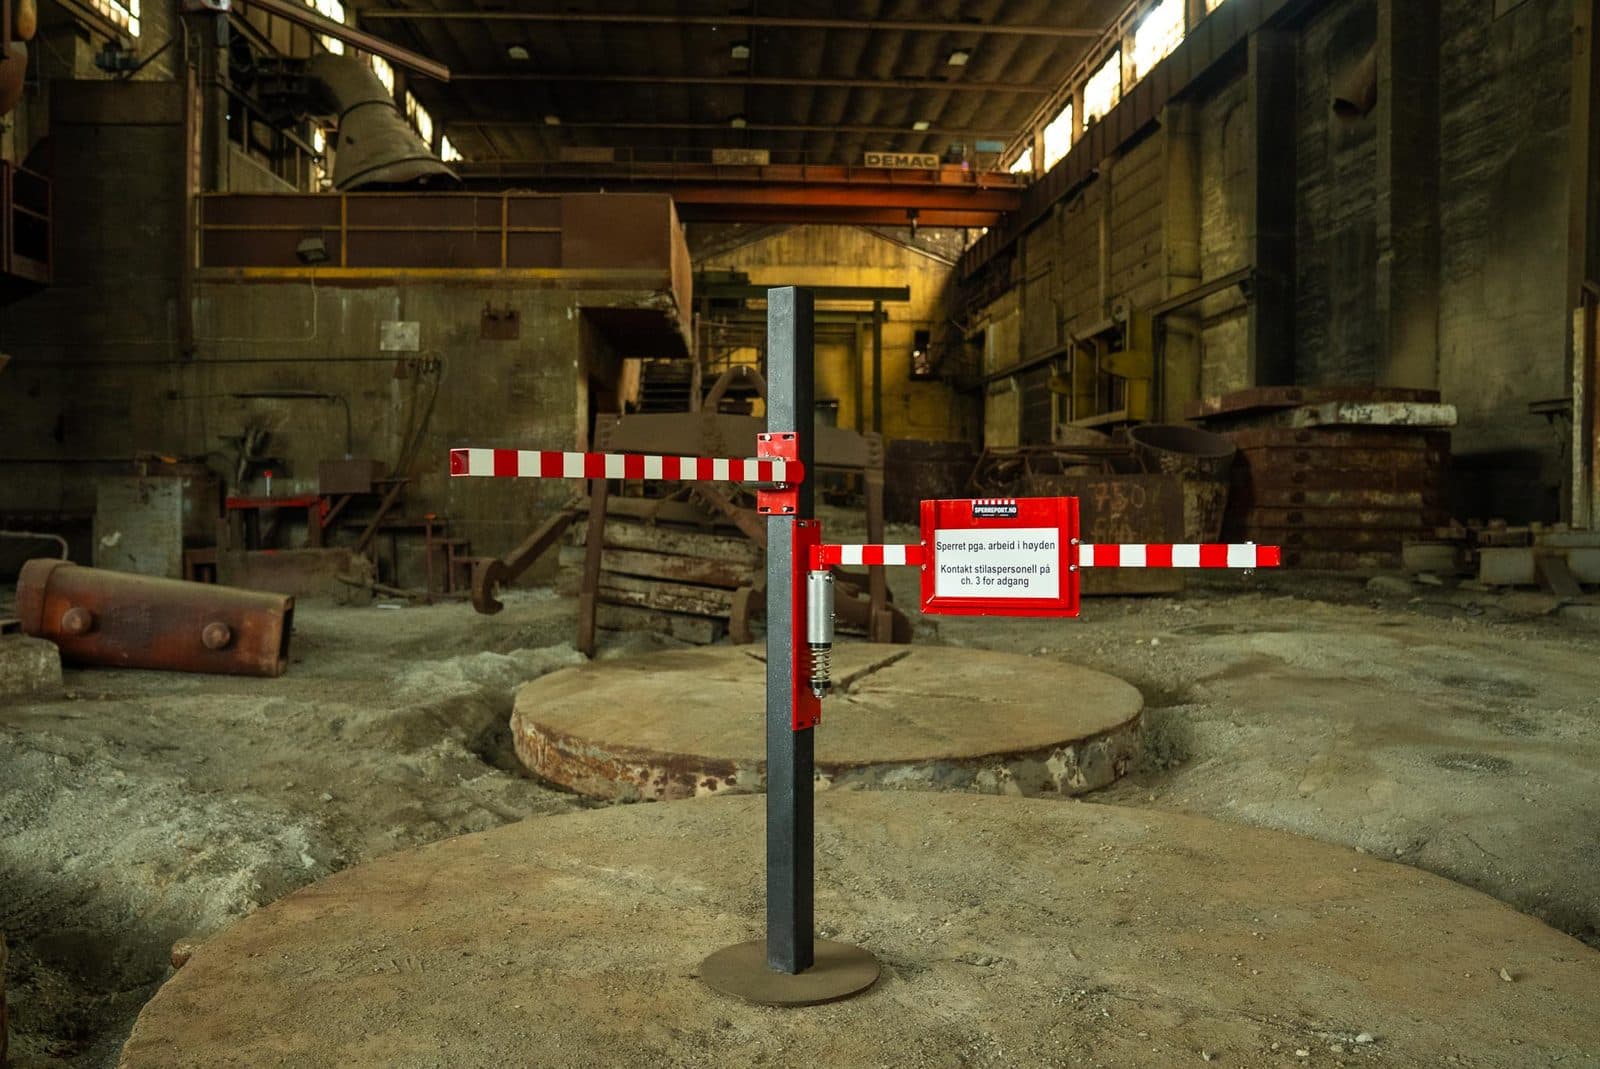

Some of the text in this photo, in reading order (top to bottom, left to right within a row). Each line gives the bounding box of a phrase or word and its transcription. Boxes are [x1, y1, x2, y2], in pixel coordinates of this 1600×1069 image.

[936, 542, 966, 552] Sperret
[968, 543, 986, 552] pga.
[988, 541, 1015, 550] arbeid
[1022, 540, 1055, 551] høyden
[940, 564, 1051, 575] Kontakt stilaspersonell på
[960, 576, 1029, 587] ch. 3 for adgang
